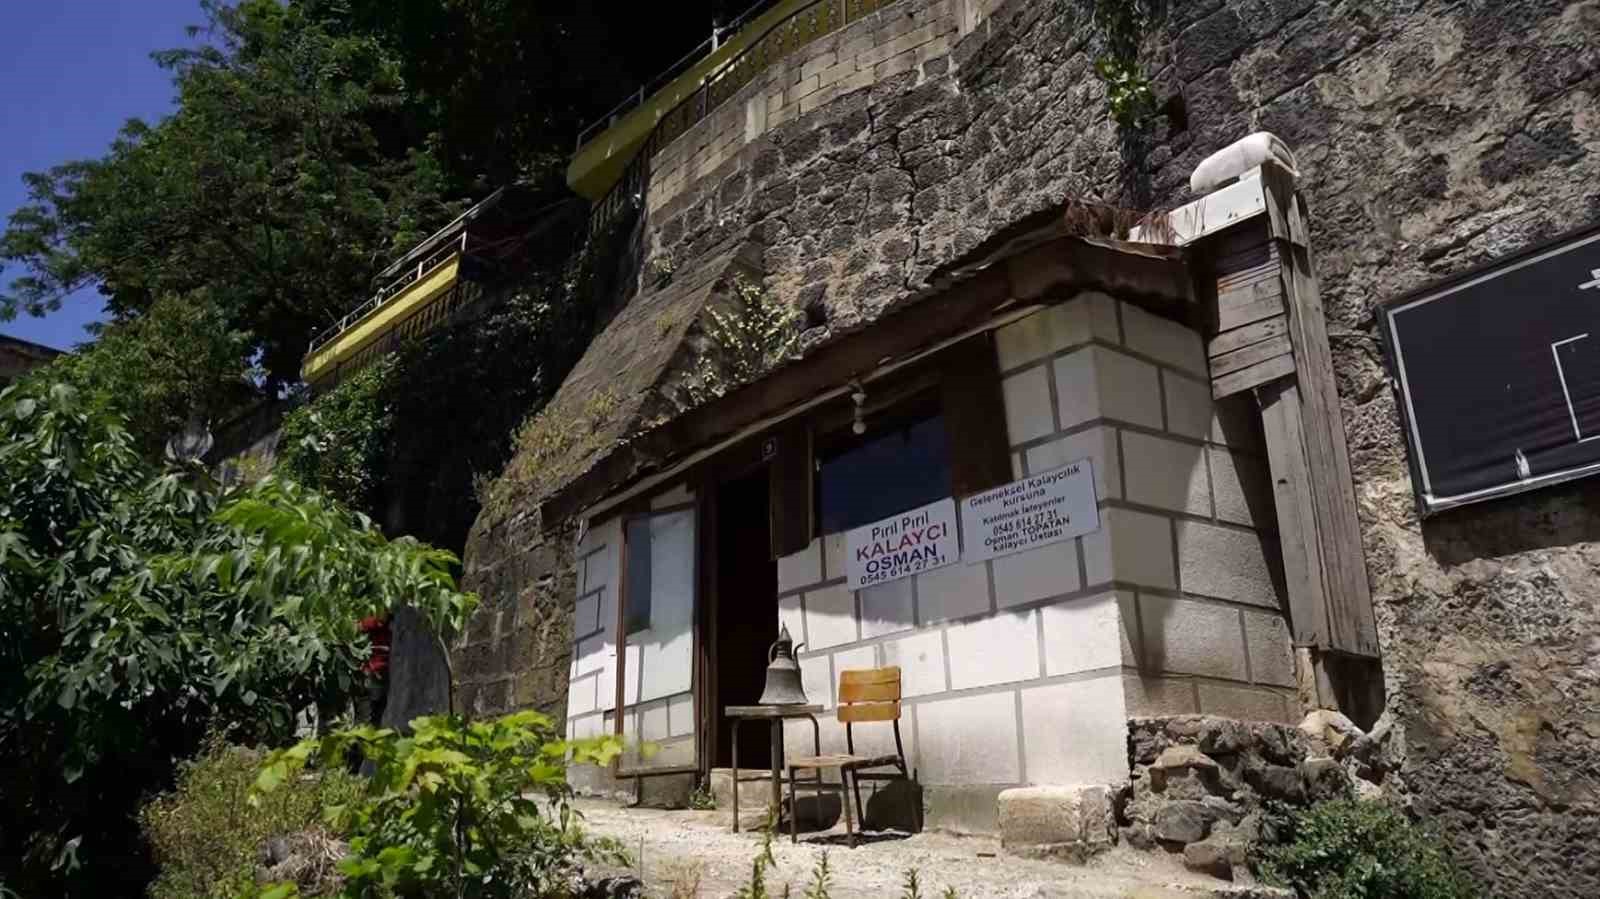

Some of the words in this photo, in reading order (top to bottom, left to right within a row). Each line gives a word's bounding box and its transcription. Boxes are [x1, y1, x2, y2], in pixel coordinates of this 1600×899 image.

[969, 482, 1025, 507] Geleneksel
[856, 521, 947, 562] KALAYCI
[984, 530, 1019, 546] Osman
[1023, 515, 1070, 535] TOPATAN
[992, 520, 1014, 536] 0545
[860, 571, 887, 585] 0545
[890, 565, 911, 577] 614
[914, 559, 929, 570] 27
[933, 555, 945, 566] 31
[866, 543, 937, 573] OSMAN
